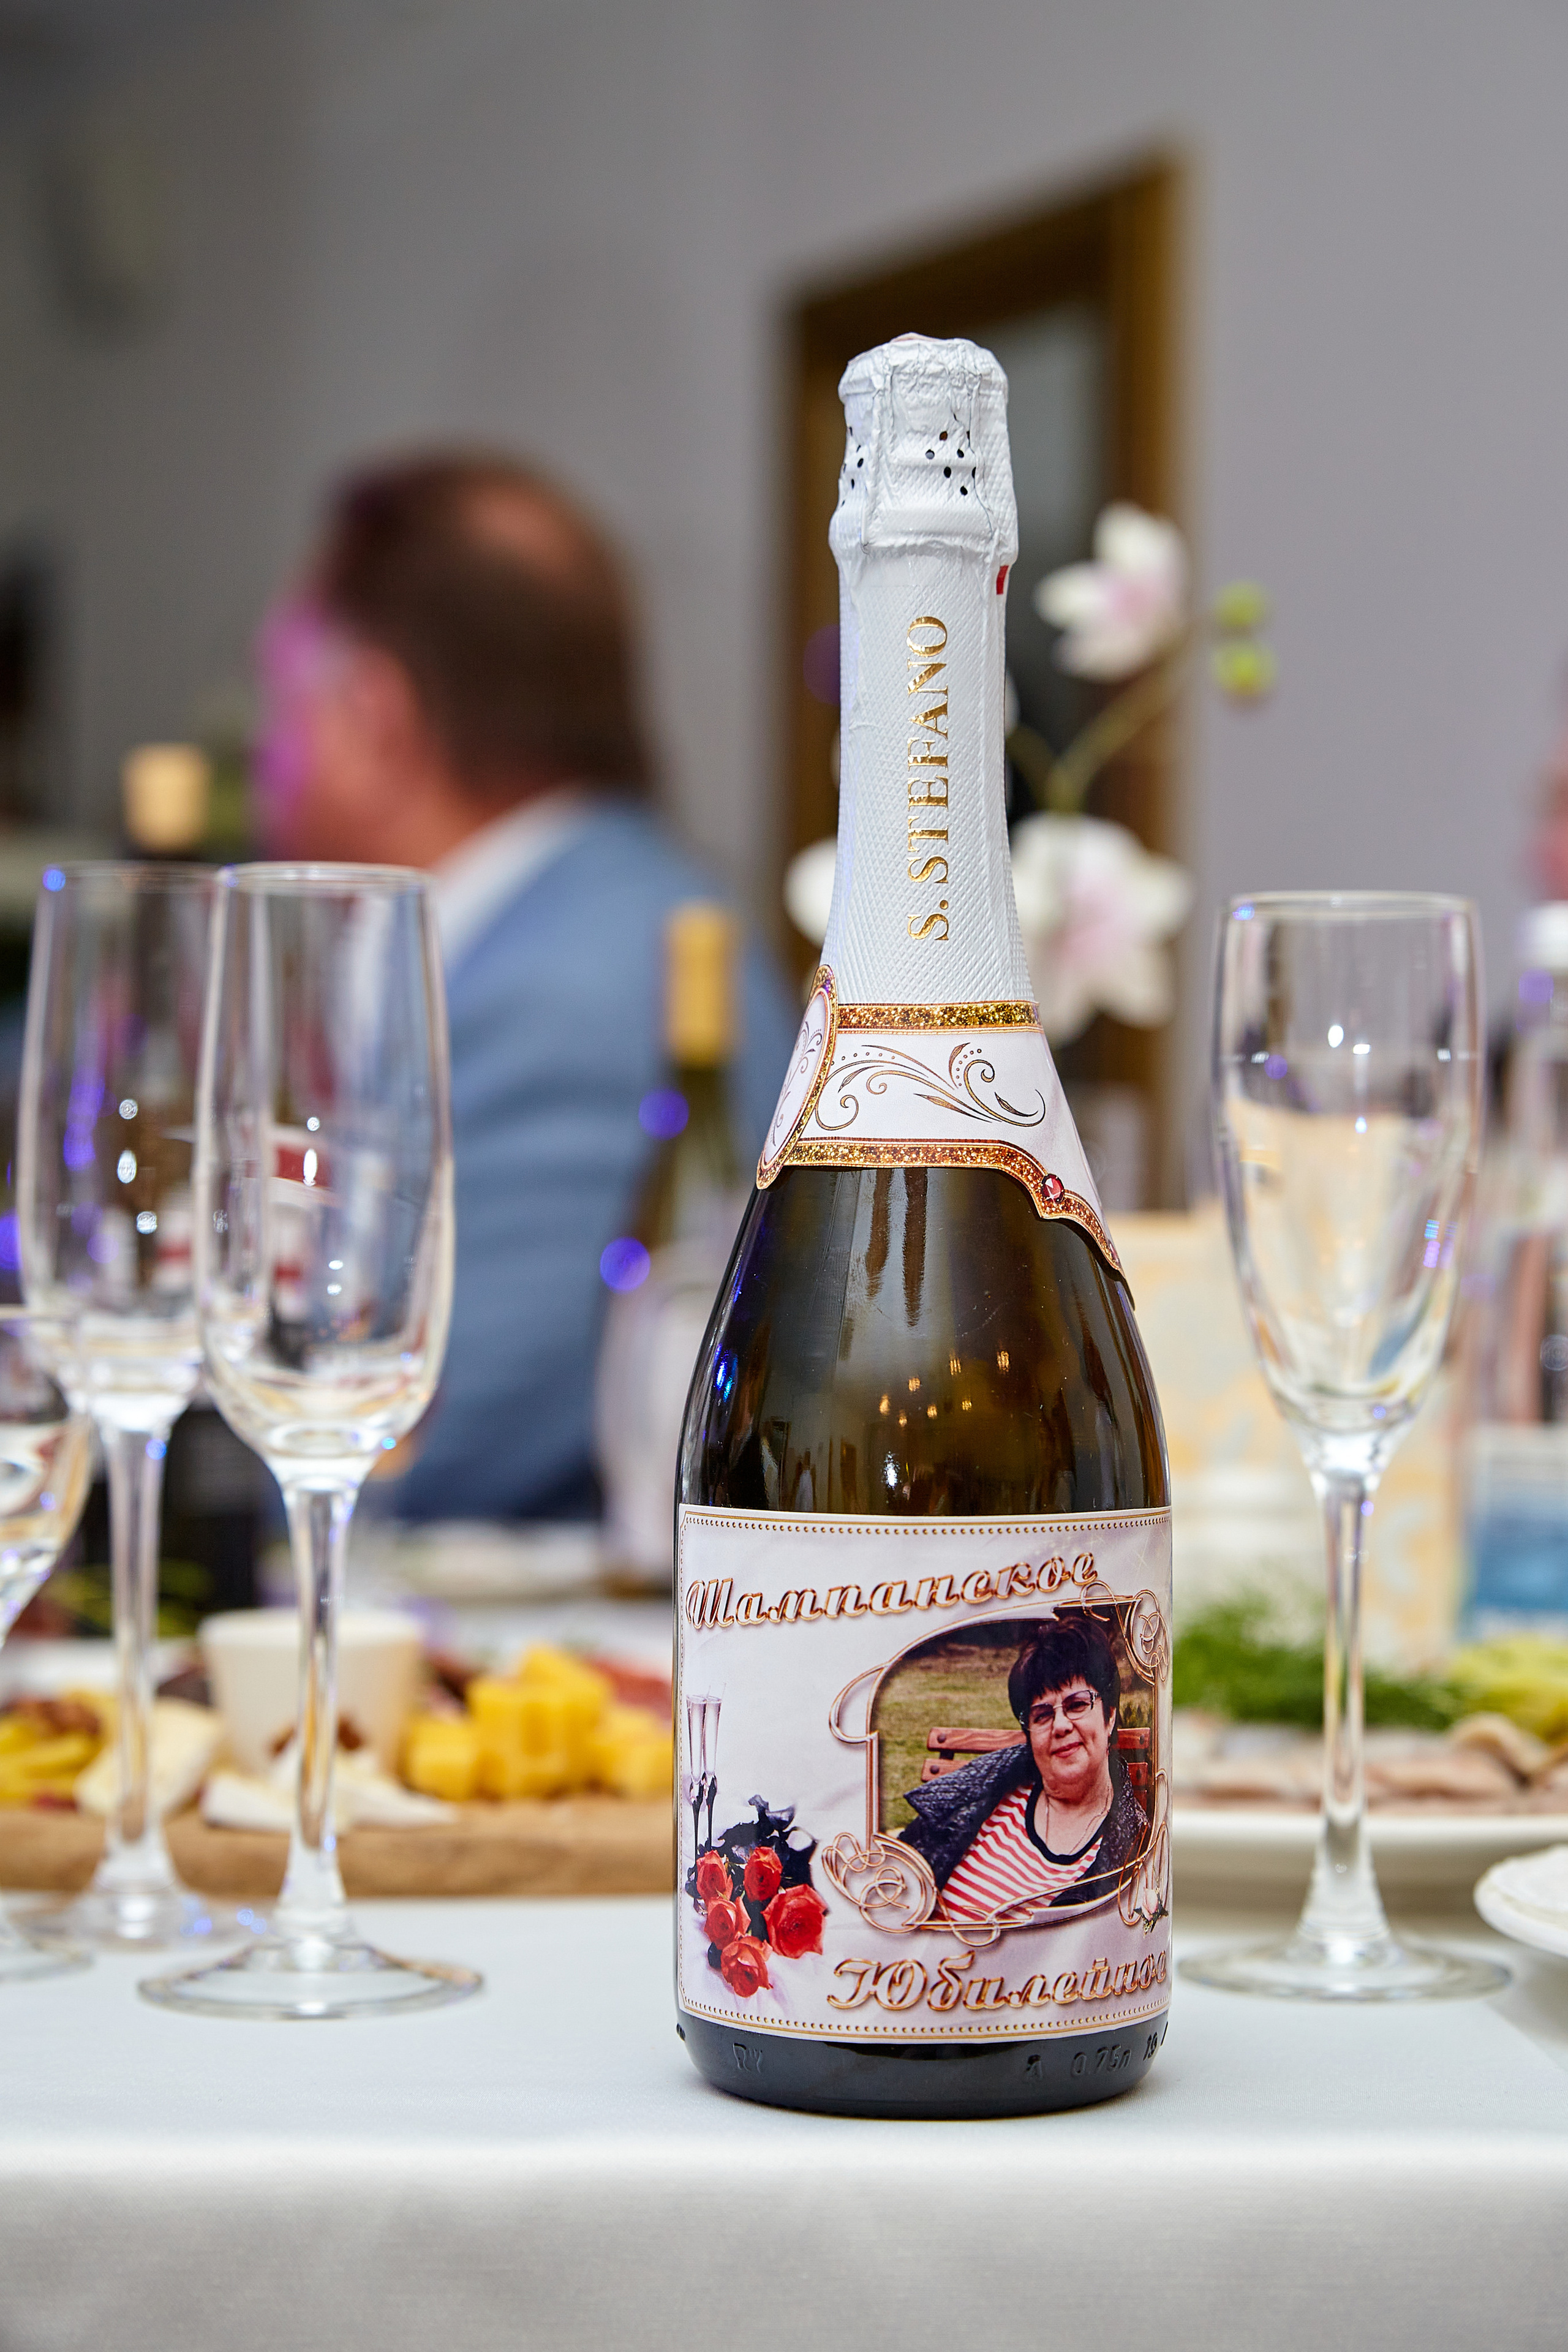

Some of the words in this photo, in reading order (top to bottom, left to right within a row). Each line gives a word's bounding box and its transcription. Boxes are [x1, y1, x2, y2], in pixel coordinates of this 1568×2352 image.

[907, 616, 949, 884] STEFANO
[907, 899, 949, 941] S.
[685, 1551, 1099, 1630] Шампанское
[827, 1950, 1167, 2011] Юбилейное
